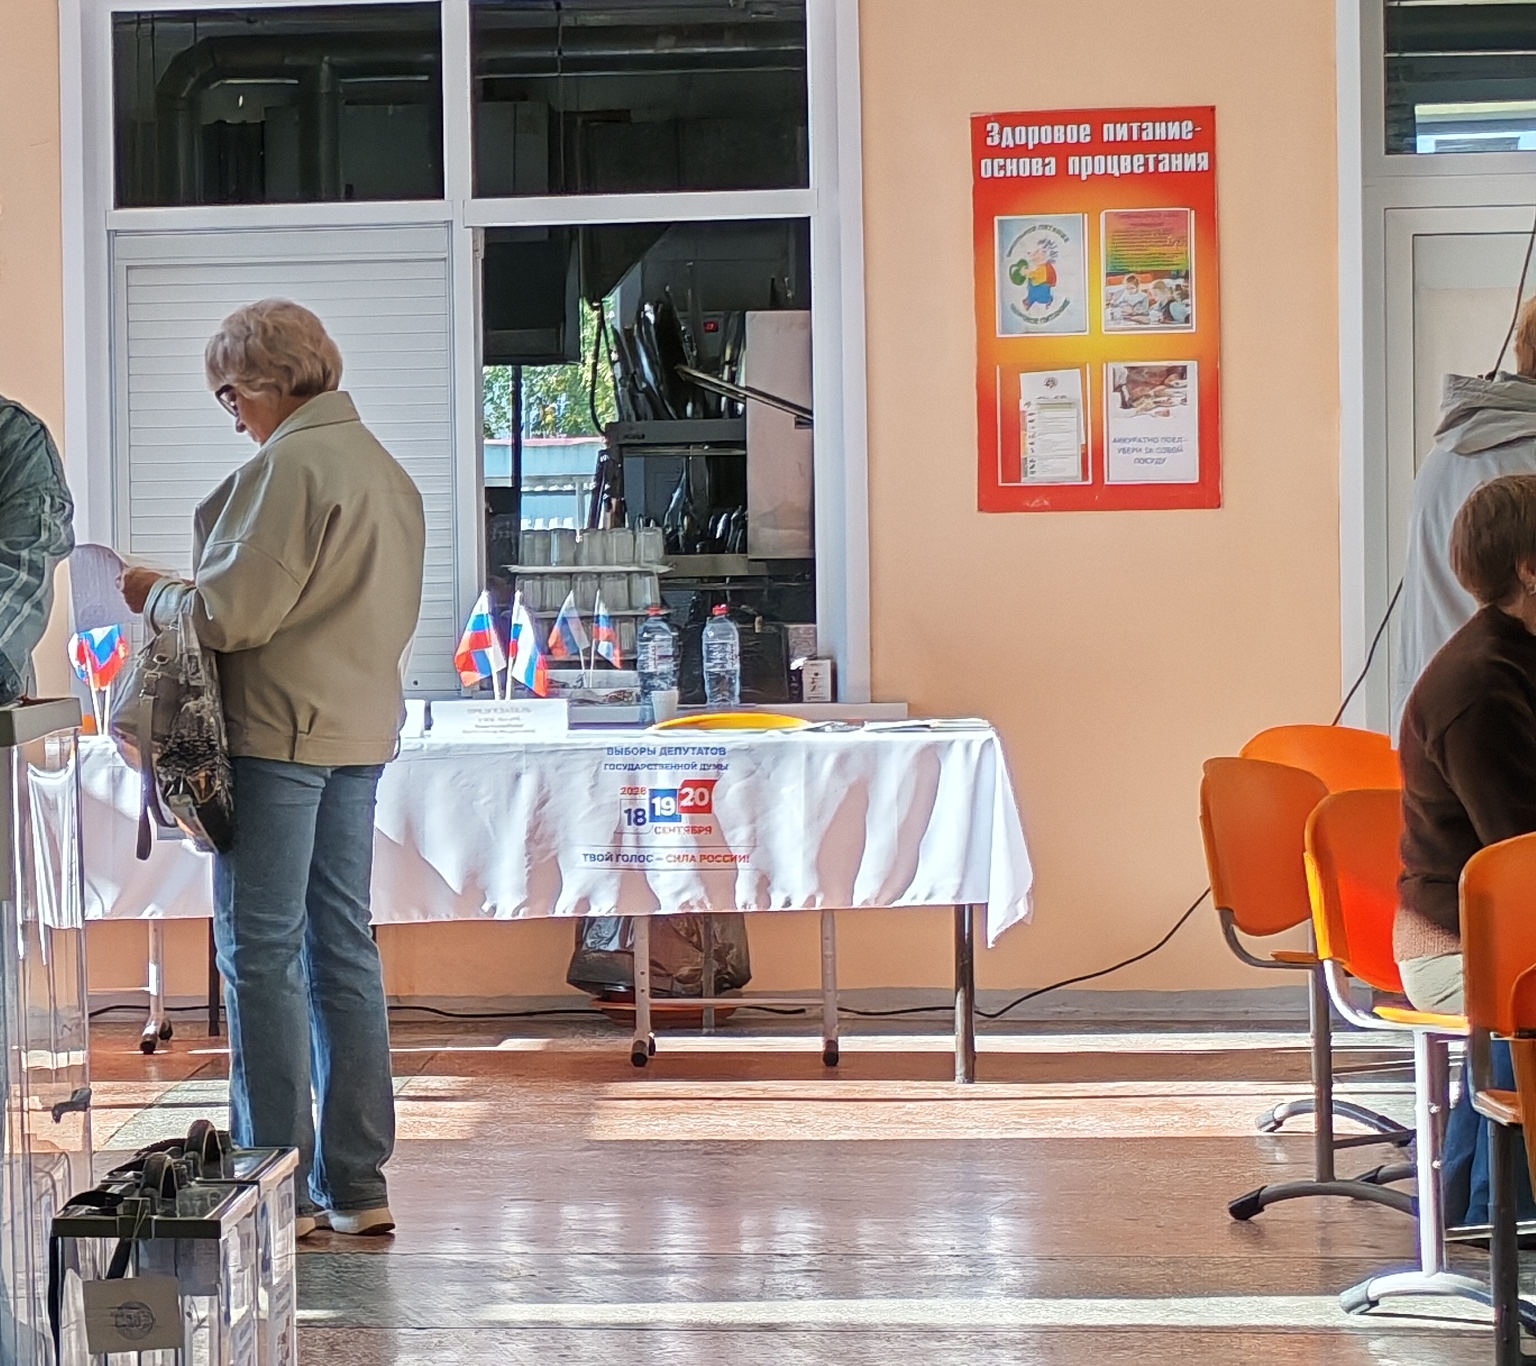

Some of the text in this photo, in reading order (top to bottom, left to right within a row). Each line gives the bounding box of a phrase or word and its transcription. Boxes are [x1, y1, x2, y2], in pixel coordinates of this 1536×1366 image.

[985, 121, 1091, 150] Здоровое
[980, 151, 1209, 181] основа процветания
[606, 746, 727, 757] ВЫБОРЫ ДЕПУТАТОВ
[603, 761, 729, 772] ГОСУДАРСТВЕННОЙ ДУМЫ
[623, 787, 710, 826] 18 19 20
[654, 825, 713, 835] СЕНТЯБРЯ
[582, 851, 614, 863] ТВОЙ
[615, 853, 654, 863] ГОЛОС
[666, 853, 696, 863] СИЛА
[699, 853, 750, 864] РОССИИ!
